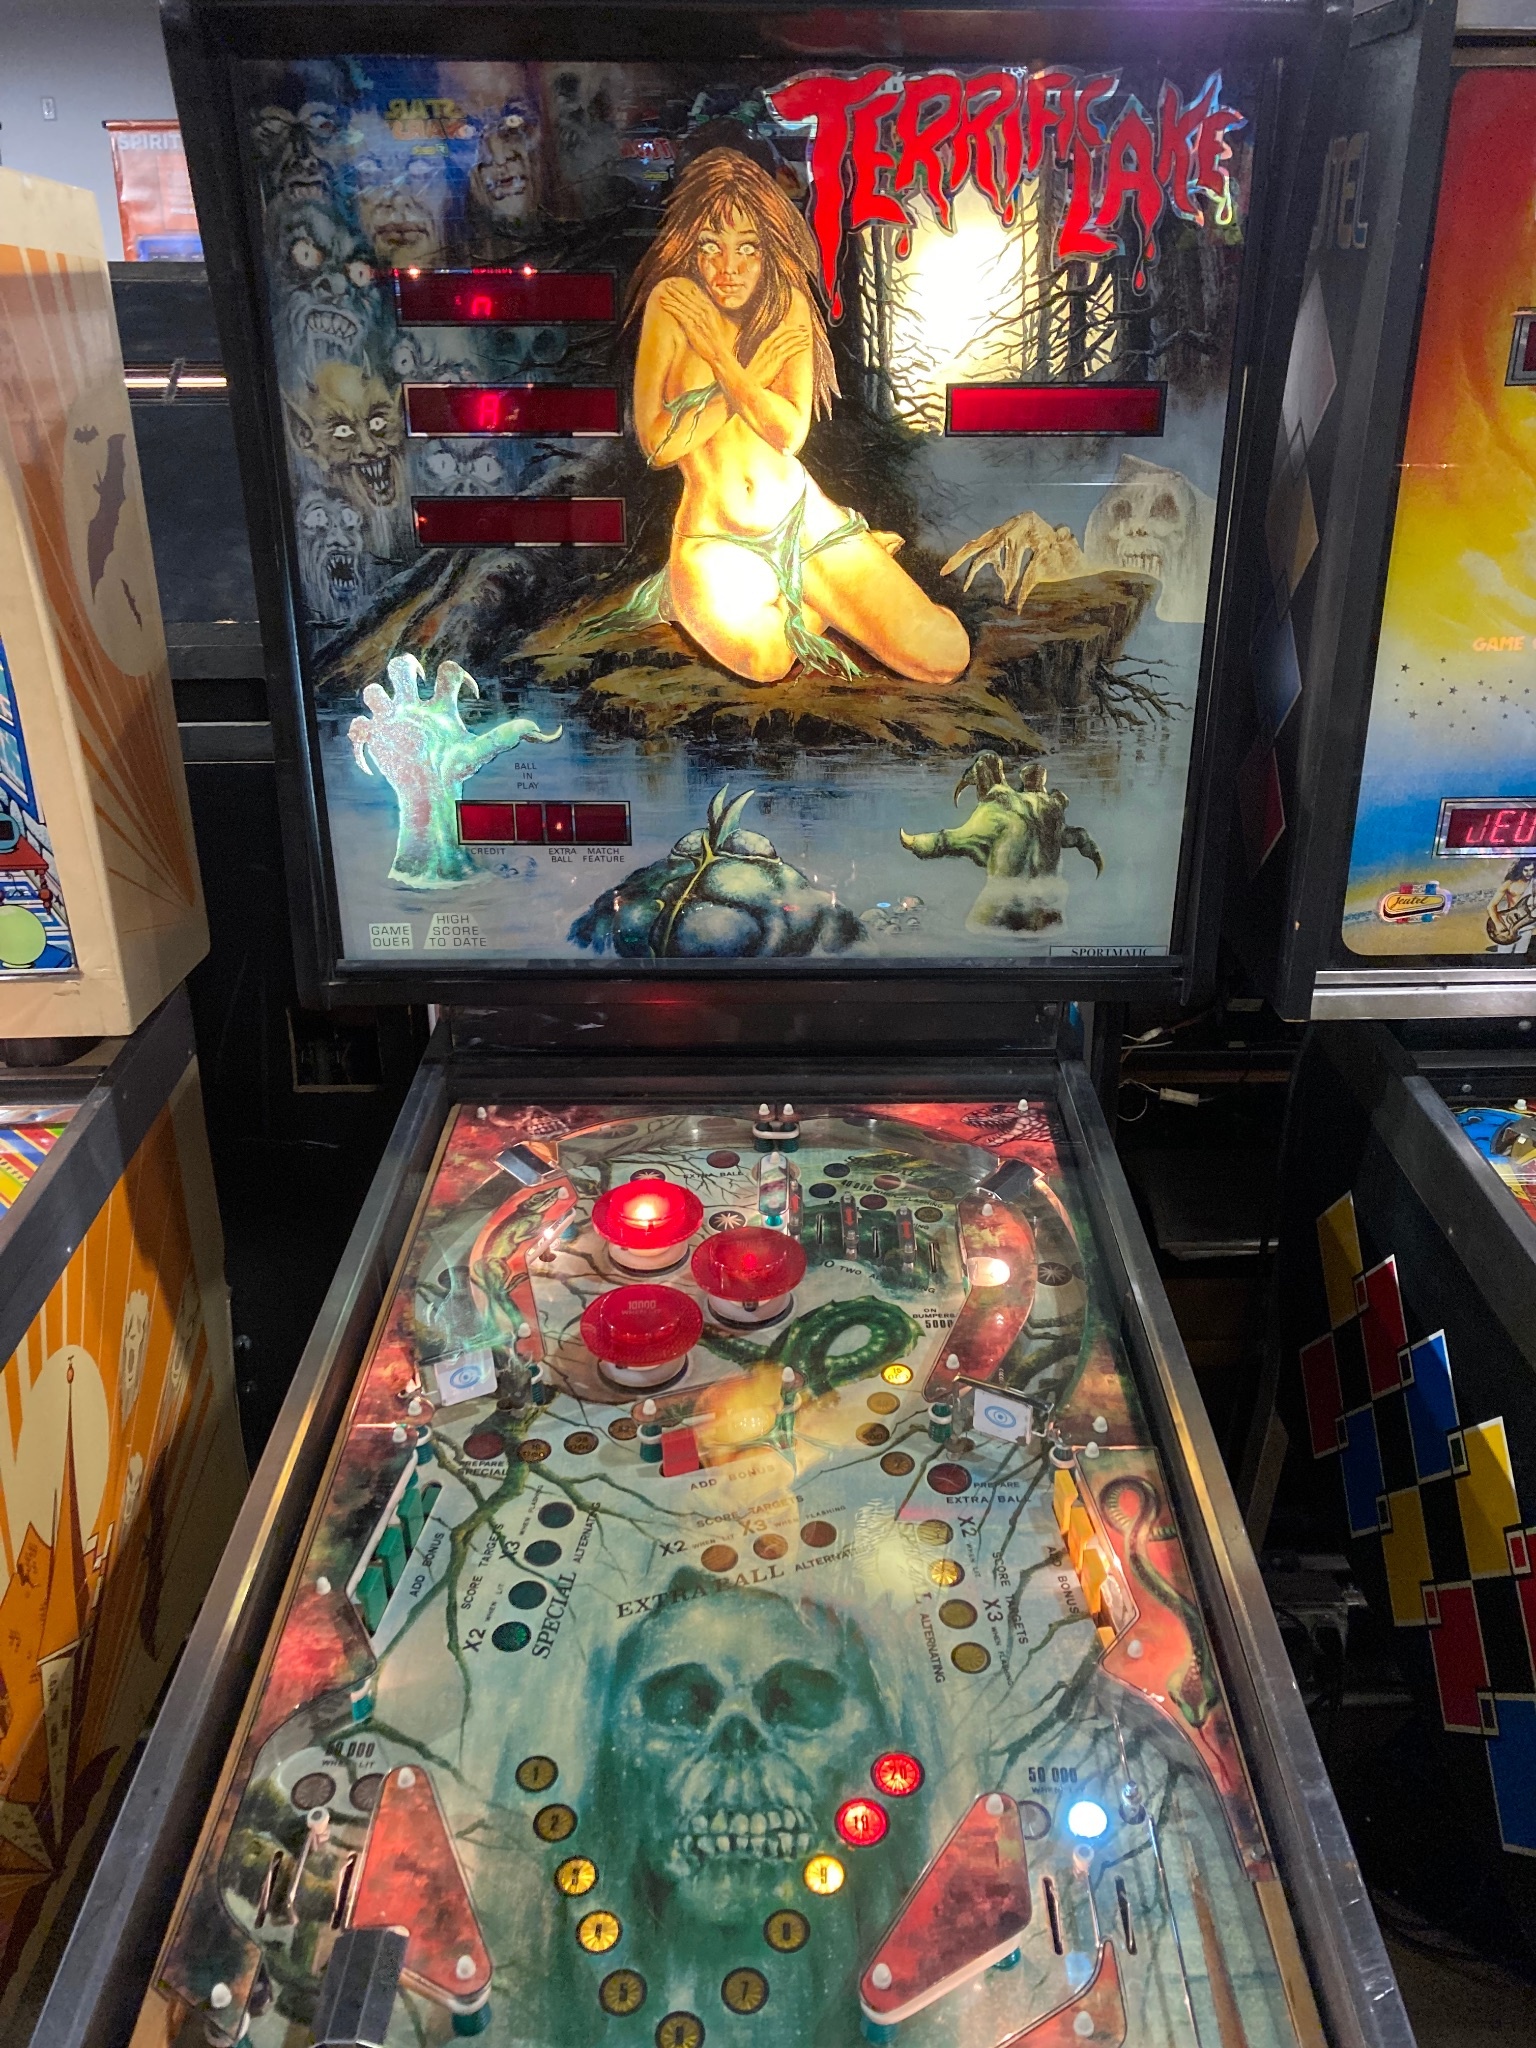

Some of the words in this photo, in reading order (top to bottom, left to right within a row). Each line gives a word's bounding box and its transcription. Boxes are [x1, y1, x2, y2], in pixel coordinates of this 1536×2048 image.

[118, 134, 180, 149] SPIRIT
[1055, 70, 1249, 275] LAKE
[1473, 636, 1525, 651] GAME
[514, 762, 538, 770] BALL
[522, 772, 533, 780] IN
[516, 782, 540, 790] PLAY
[470, 847, 506, 856] CREDIT
[548, 847, 577, 855] EXTRA
[587, 847, 620, 855] MATCH
[551, 855, 573, 863] BALL
[582, 855, 626, 863] FEATURE
[436, 914, 470, 924] HIGH
[371, 926, 410, 936] GAME
[432, 926, 479, 936] SCORE
[372, 937, 410, 947] OVER
[429, 937, 447, 947] TO
[453, 937, 487, 947] DATE
[1071, 947, 1152, 957] SPORTMATIC
[839, 1265, 862, 1275] TWO
[457, 1468, 507, 1476] SPECIAL
[690, 1478, 717, 1491] ADD
[728, 1465, 776, 1481] BONUS
[973, 1481, 1021, 1489] PREPARE
[946, 1496, 989, 1504] EXTRA
[997, 1495, 1031, 1504] BALL
[696, 1511, 741, 1528] SCORE
[747, 1494, 804, 1514] TARGETS
[658, 1539, 688, 1558] X2
[692, 1538, 717, 1549] WHEN
[741, 1518, 768, 1537] X3
[805, 1505, 847, 1519] FLASHING
[957, 1516, 978, 1538] X2
[409, 1574, 425, 1598] ADD
[422, 1532, 445, 1567] BONUS
[992, 1551, 1011, 1587] SCORE
[461, 1575, 484, 1610] SCORE
[463, 1628, 487, 1653] X2
[499, 1540, 521, 1560] X3
[616, 1583, 708, 1620] EXTRA
[716, 1564, 785, 1593] BALL
[1057, 1575, 1080, 1613] BONUS
[531, 1571, 577, 1660] SPECIAL
[982, 1598, 1004, 1622] X3
[920, 1612, 946, 1684] ALTERNATING
[1028, 1766, 1046, 1783] 50
[1051, 1766, 1078, 1783] 000
[820, 1866, 828, 1884] 9
